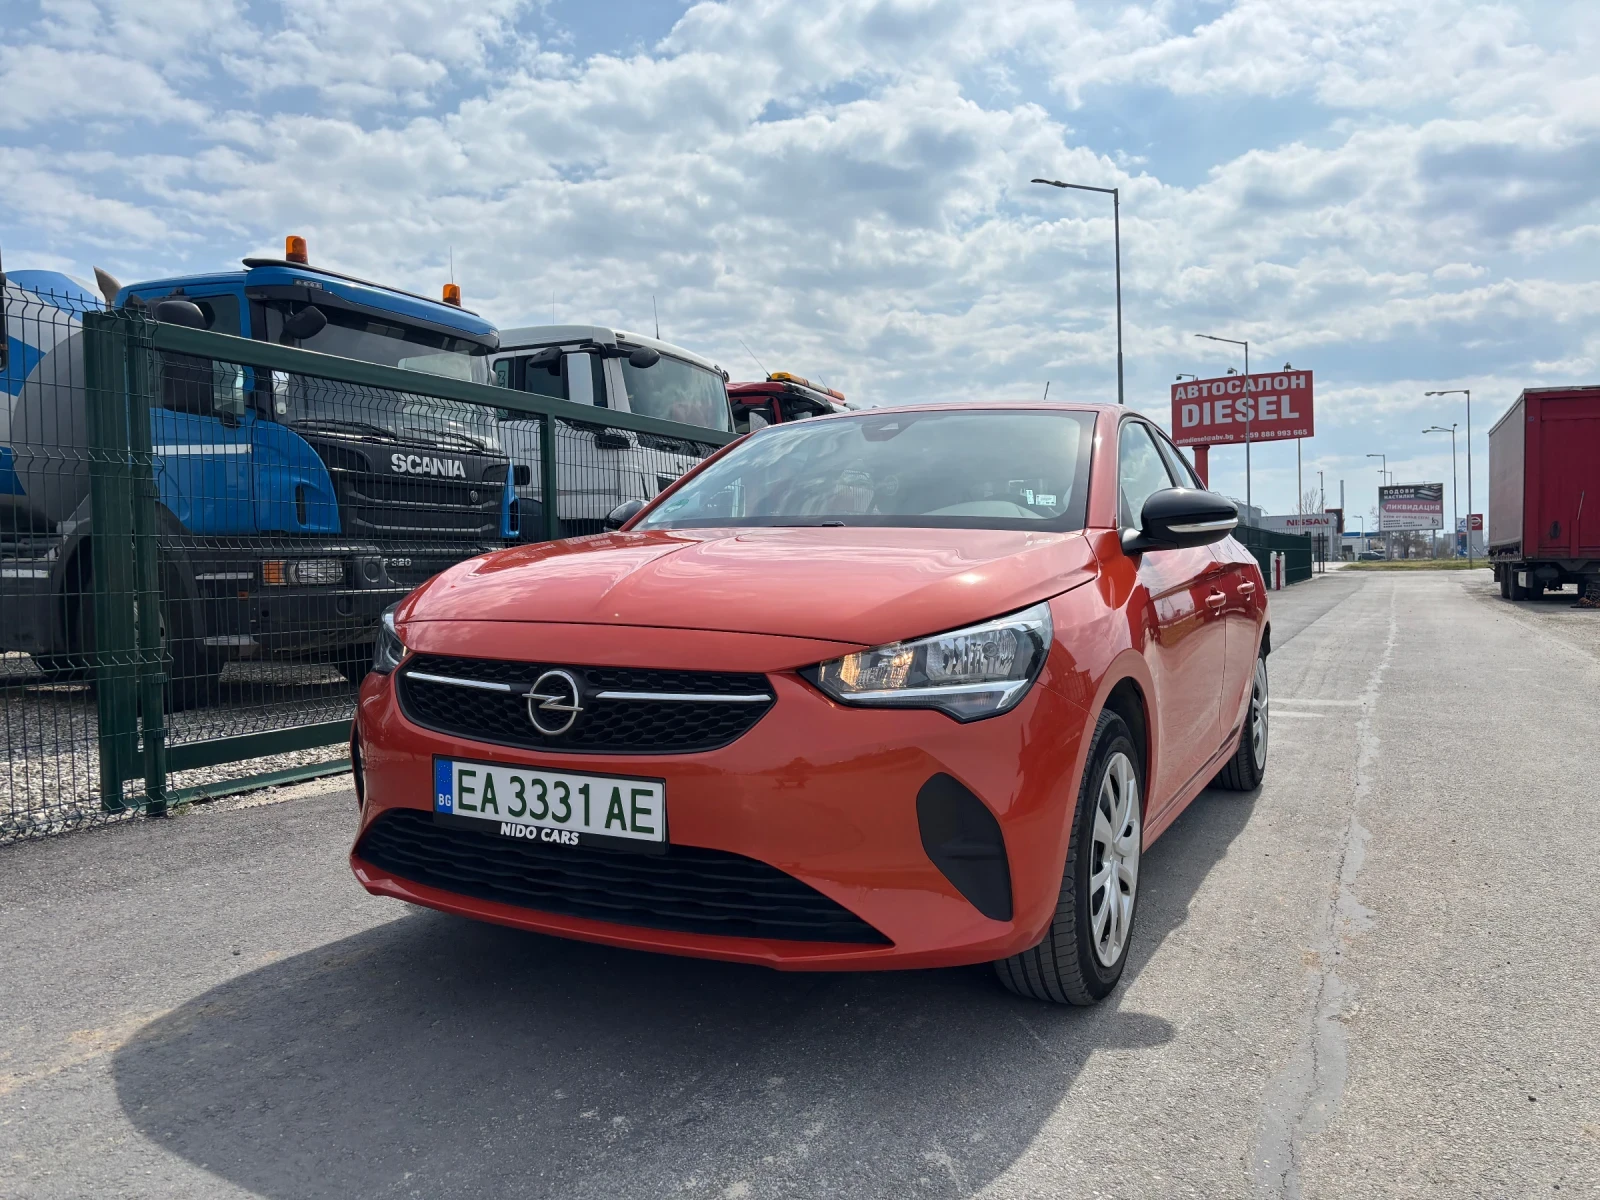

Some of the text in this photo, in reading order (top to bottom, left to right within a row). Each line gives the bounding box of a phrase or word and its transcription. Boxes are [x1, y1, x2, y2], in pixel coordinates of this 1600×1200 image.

[1175, 374, 1306, 400] АВТОСАЛОН
[1181, 394, 1300, 428] DIESEL
[391, 453, 466, 478] SCANIA
[1385, 503, 1440, 511] ЛИКВИДАЦИЯ
[1286, 518, 1329, 526] NISSAN
[438, 793, 451, 807] BG
[500, 822, 579, 845] NIDO CARS
